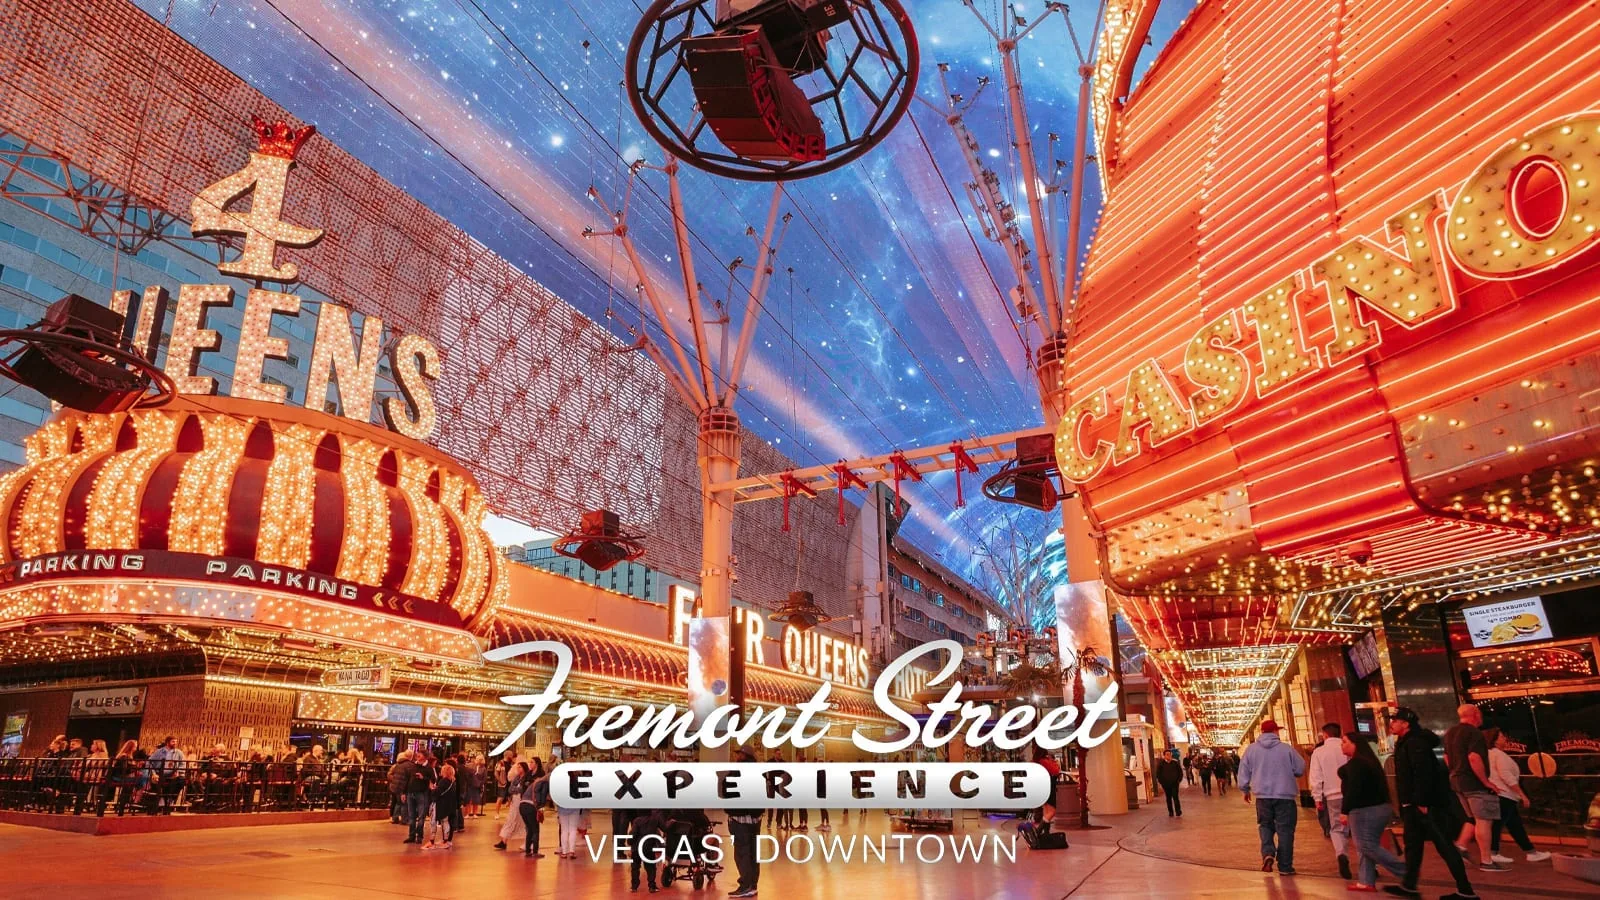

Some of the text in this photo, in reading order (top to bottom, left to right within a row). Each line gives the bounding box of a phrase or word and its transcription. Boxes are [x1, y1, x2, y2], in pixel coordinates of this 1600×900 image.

[190, 150, 323, 281] 4
[1054, 109, 1600, 485] CASINO
[102, 283, 441, 440] UEENS
[20, 553, 359, 600] PARKING PARKING
[1469, 608, 1490, 617] SINGLE
[1491, 601, 1536, 614] STEAKBURGER
[670, 585, 765, 664] FR
[783, 624, 870, 688] QUEENS
[85, 695, 140, 708] QUEENS
[1554, 738, 1600, 752] FREMON
